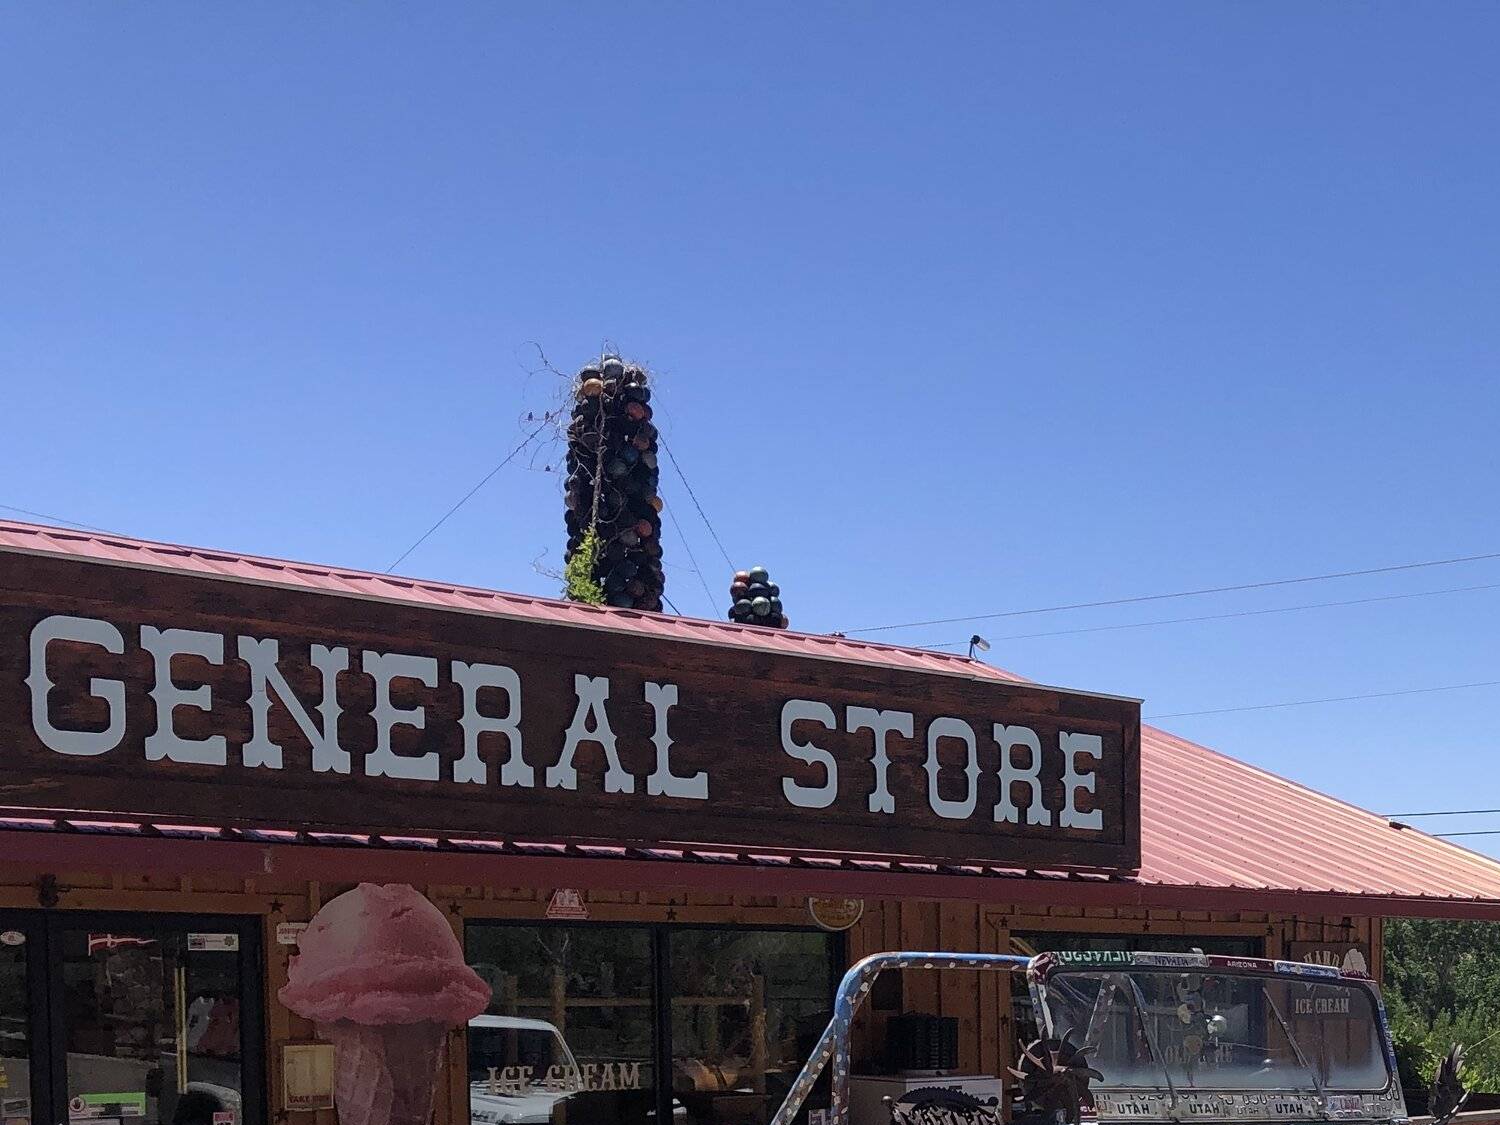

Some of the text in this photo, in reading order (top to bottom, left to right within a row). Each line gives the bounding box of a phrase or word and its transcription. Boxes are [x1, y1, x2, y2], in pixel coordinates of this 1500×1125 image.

[24, 615, 1103, 830] GENERAL STORE
[1226, 961, 1258, 969] ARIZONA
[1295, 998, 1350, 1014] ICE CREAM
[545, 1063, 642, 1092] CREAM
[1118, 1103, 1150, 1115] UTAH
[1189, 1103, 1220, 1114] UTAH
[1275, 1103, 1303, 1114] UTAH
